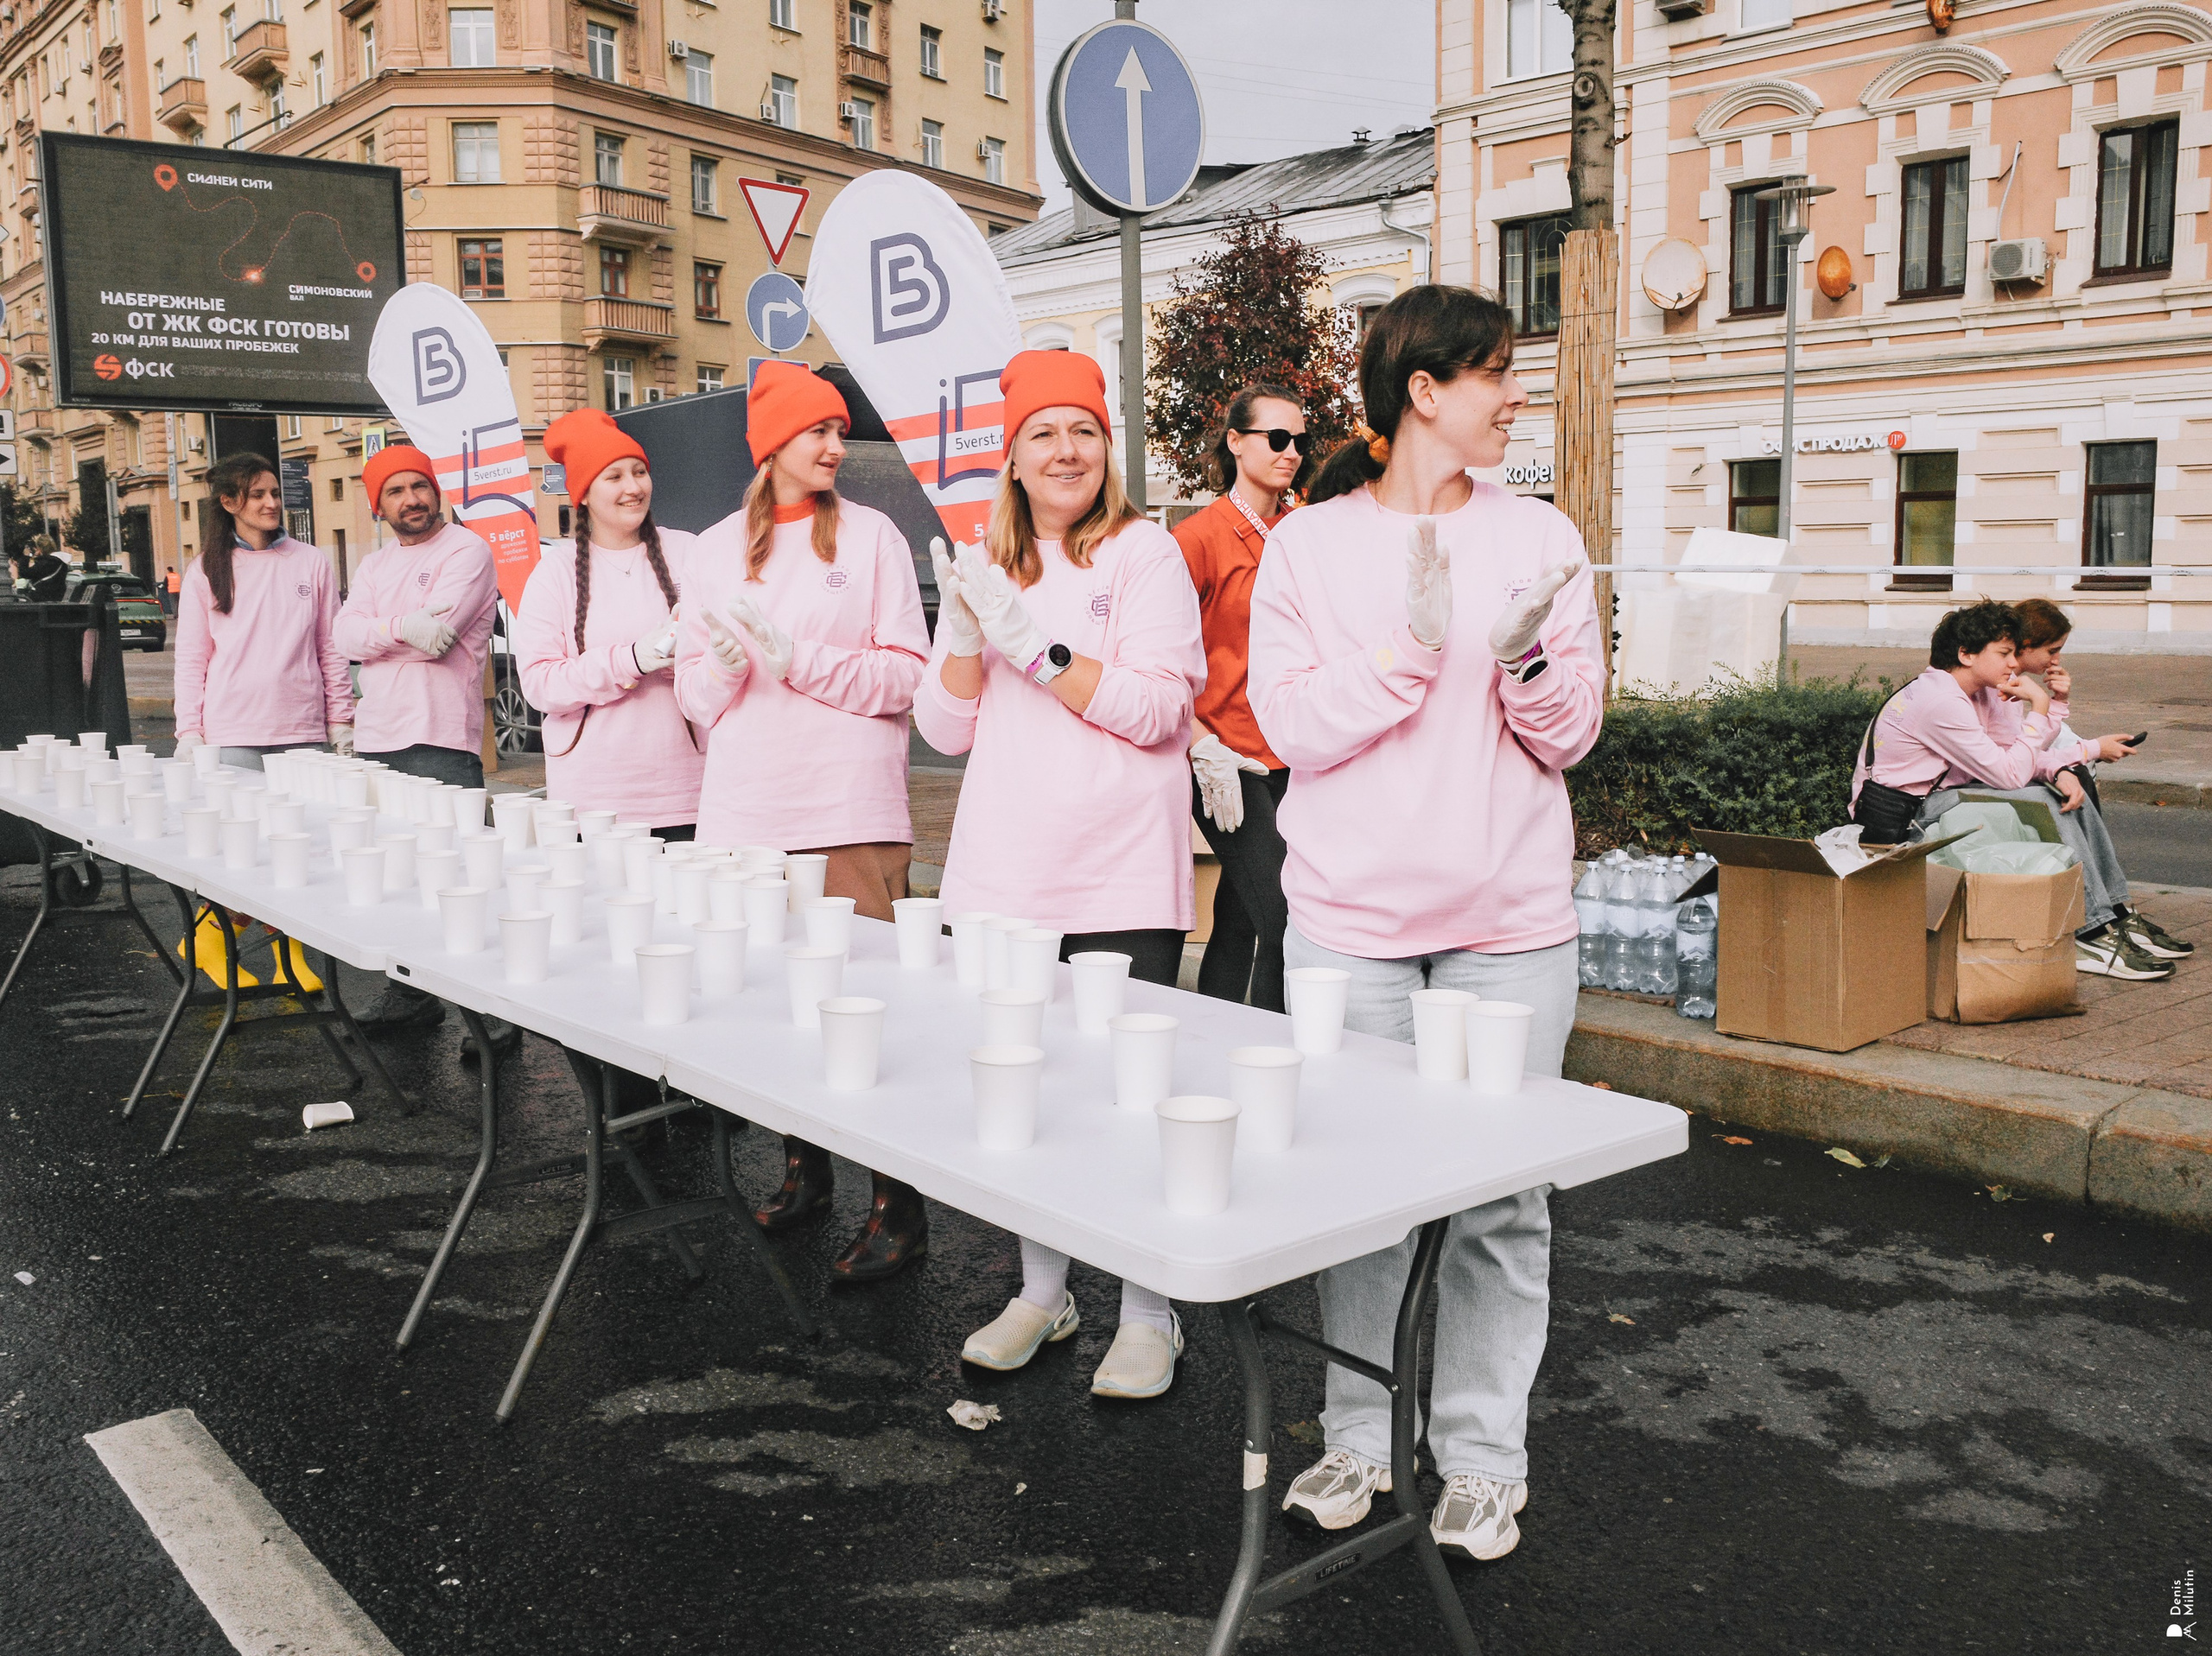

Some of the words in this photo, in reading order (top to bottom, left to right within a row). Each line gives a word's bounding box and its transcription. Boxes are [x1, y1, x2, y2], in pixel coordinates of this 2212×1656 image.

[241, 178, 273, 190] СИТИ
[100, 290, 226, 312] НАБЕРЕЖНЫЕ
[128, 312, 156, 330] ОТ
[162, 314, 202, 333] ЖК
[207, 316, 258, 336] ФСК
[264, 320, 350, 341] ГОТОВЫ
[91, 333, 109, 344] 20
[113, 333, 135, 346] КМ
[138, 334, 168, 348] ДЛЯ
[172, 336, 222, 350] ВАШИХ
[226, 339, 300, 353] ПРОБЕЖЕК
[125, 358, 175, 379] ФСК
[955, 432, 1004, 450] 5verst.r
[1811, 434, 1885, 451] ПРОДАЖ
[474, 466, 512, 481] 5verst.ru
[489, 532, 497, 542] 5
[499, 529, 525, 542] вёрст
[974, 523, 984, 537] 5
[1319, 1555, 1356, 1578] LIFETIME
